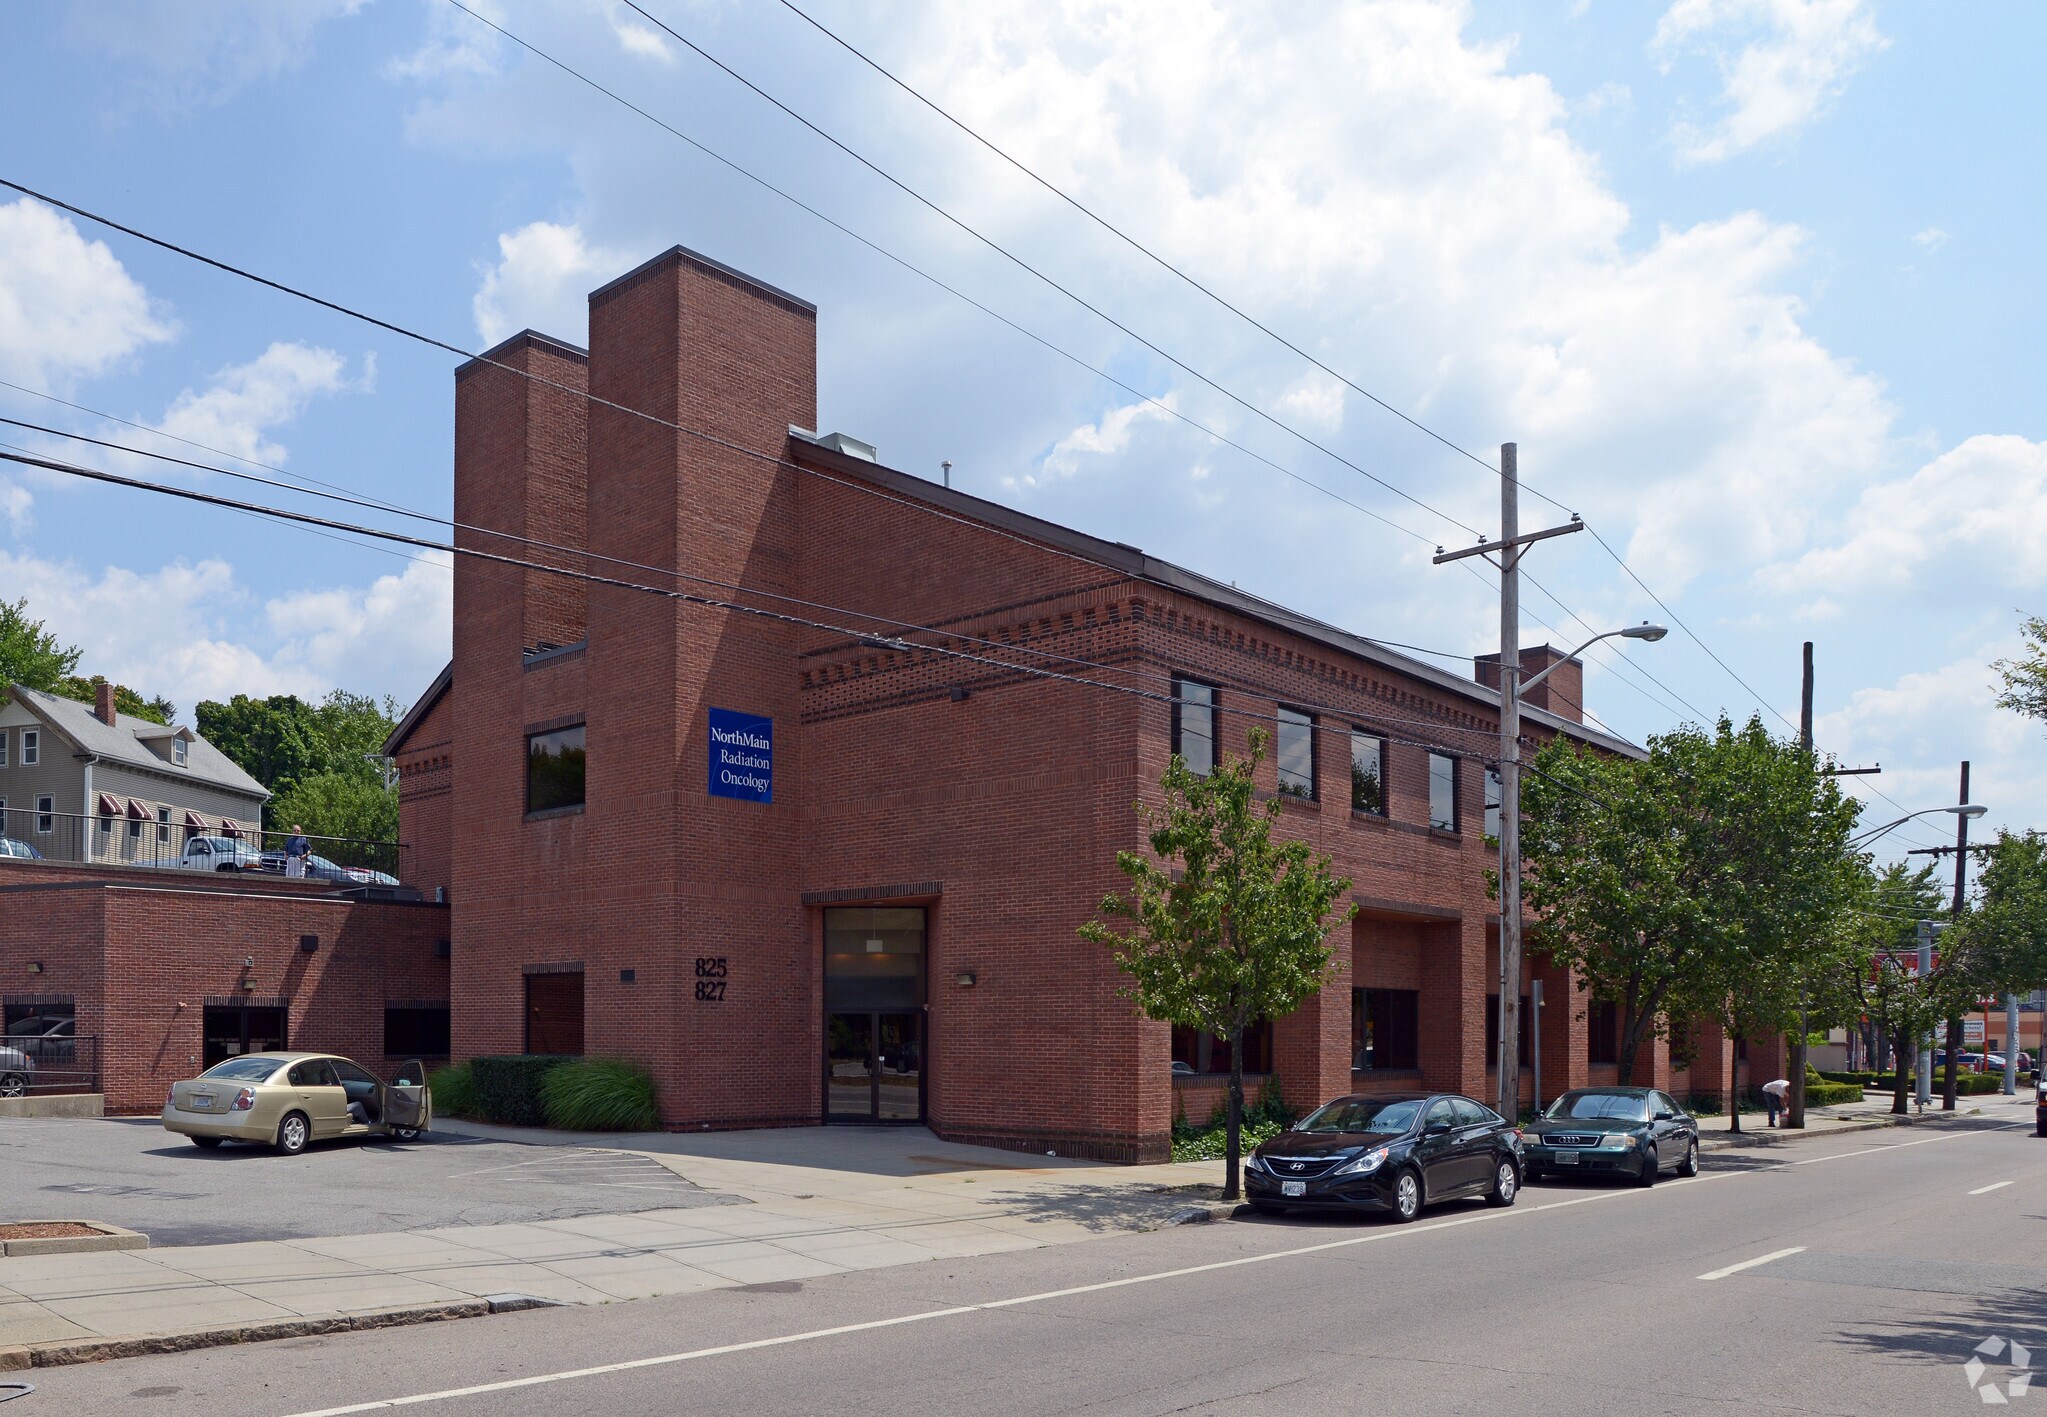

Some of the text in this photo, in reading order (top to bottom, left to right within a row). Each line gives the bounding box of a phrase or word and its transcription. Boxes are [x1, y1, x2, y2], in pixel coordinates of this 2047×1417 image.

[711, 727, 770, 750] NorthMain
[721, 749, 770, 770] Radiation
[721, 769, 770, 793] Oncology
[695, 957, 727, 978] 825
[695, 981, 727, 1001] 827
